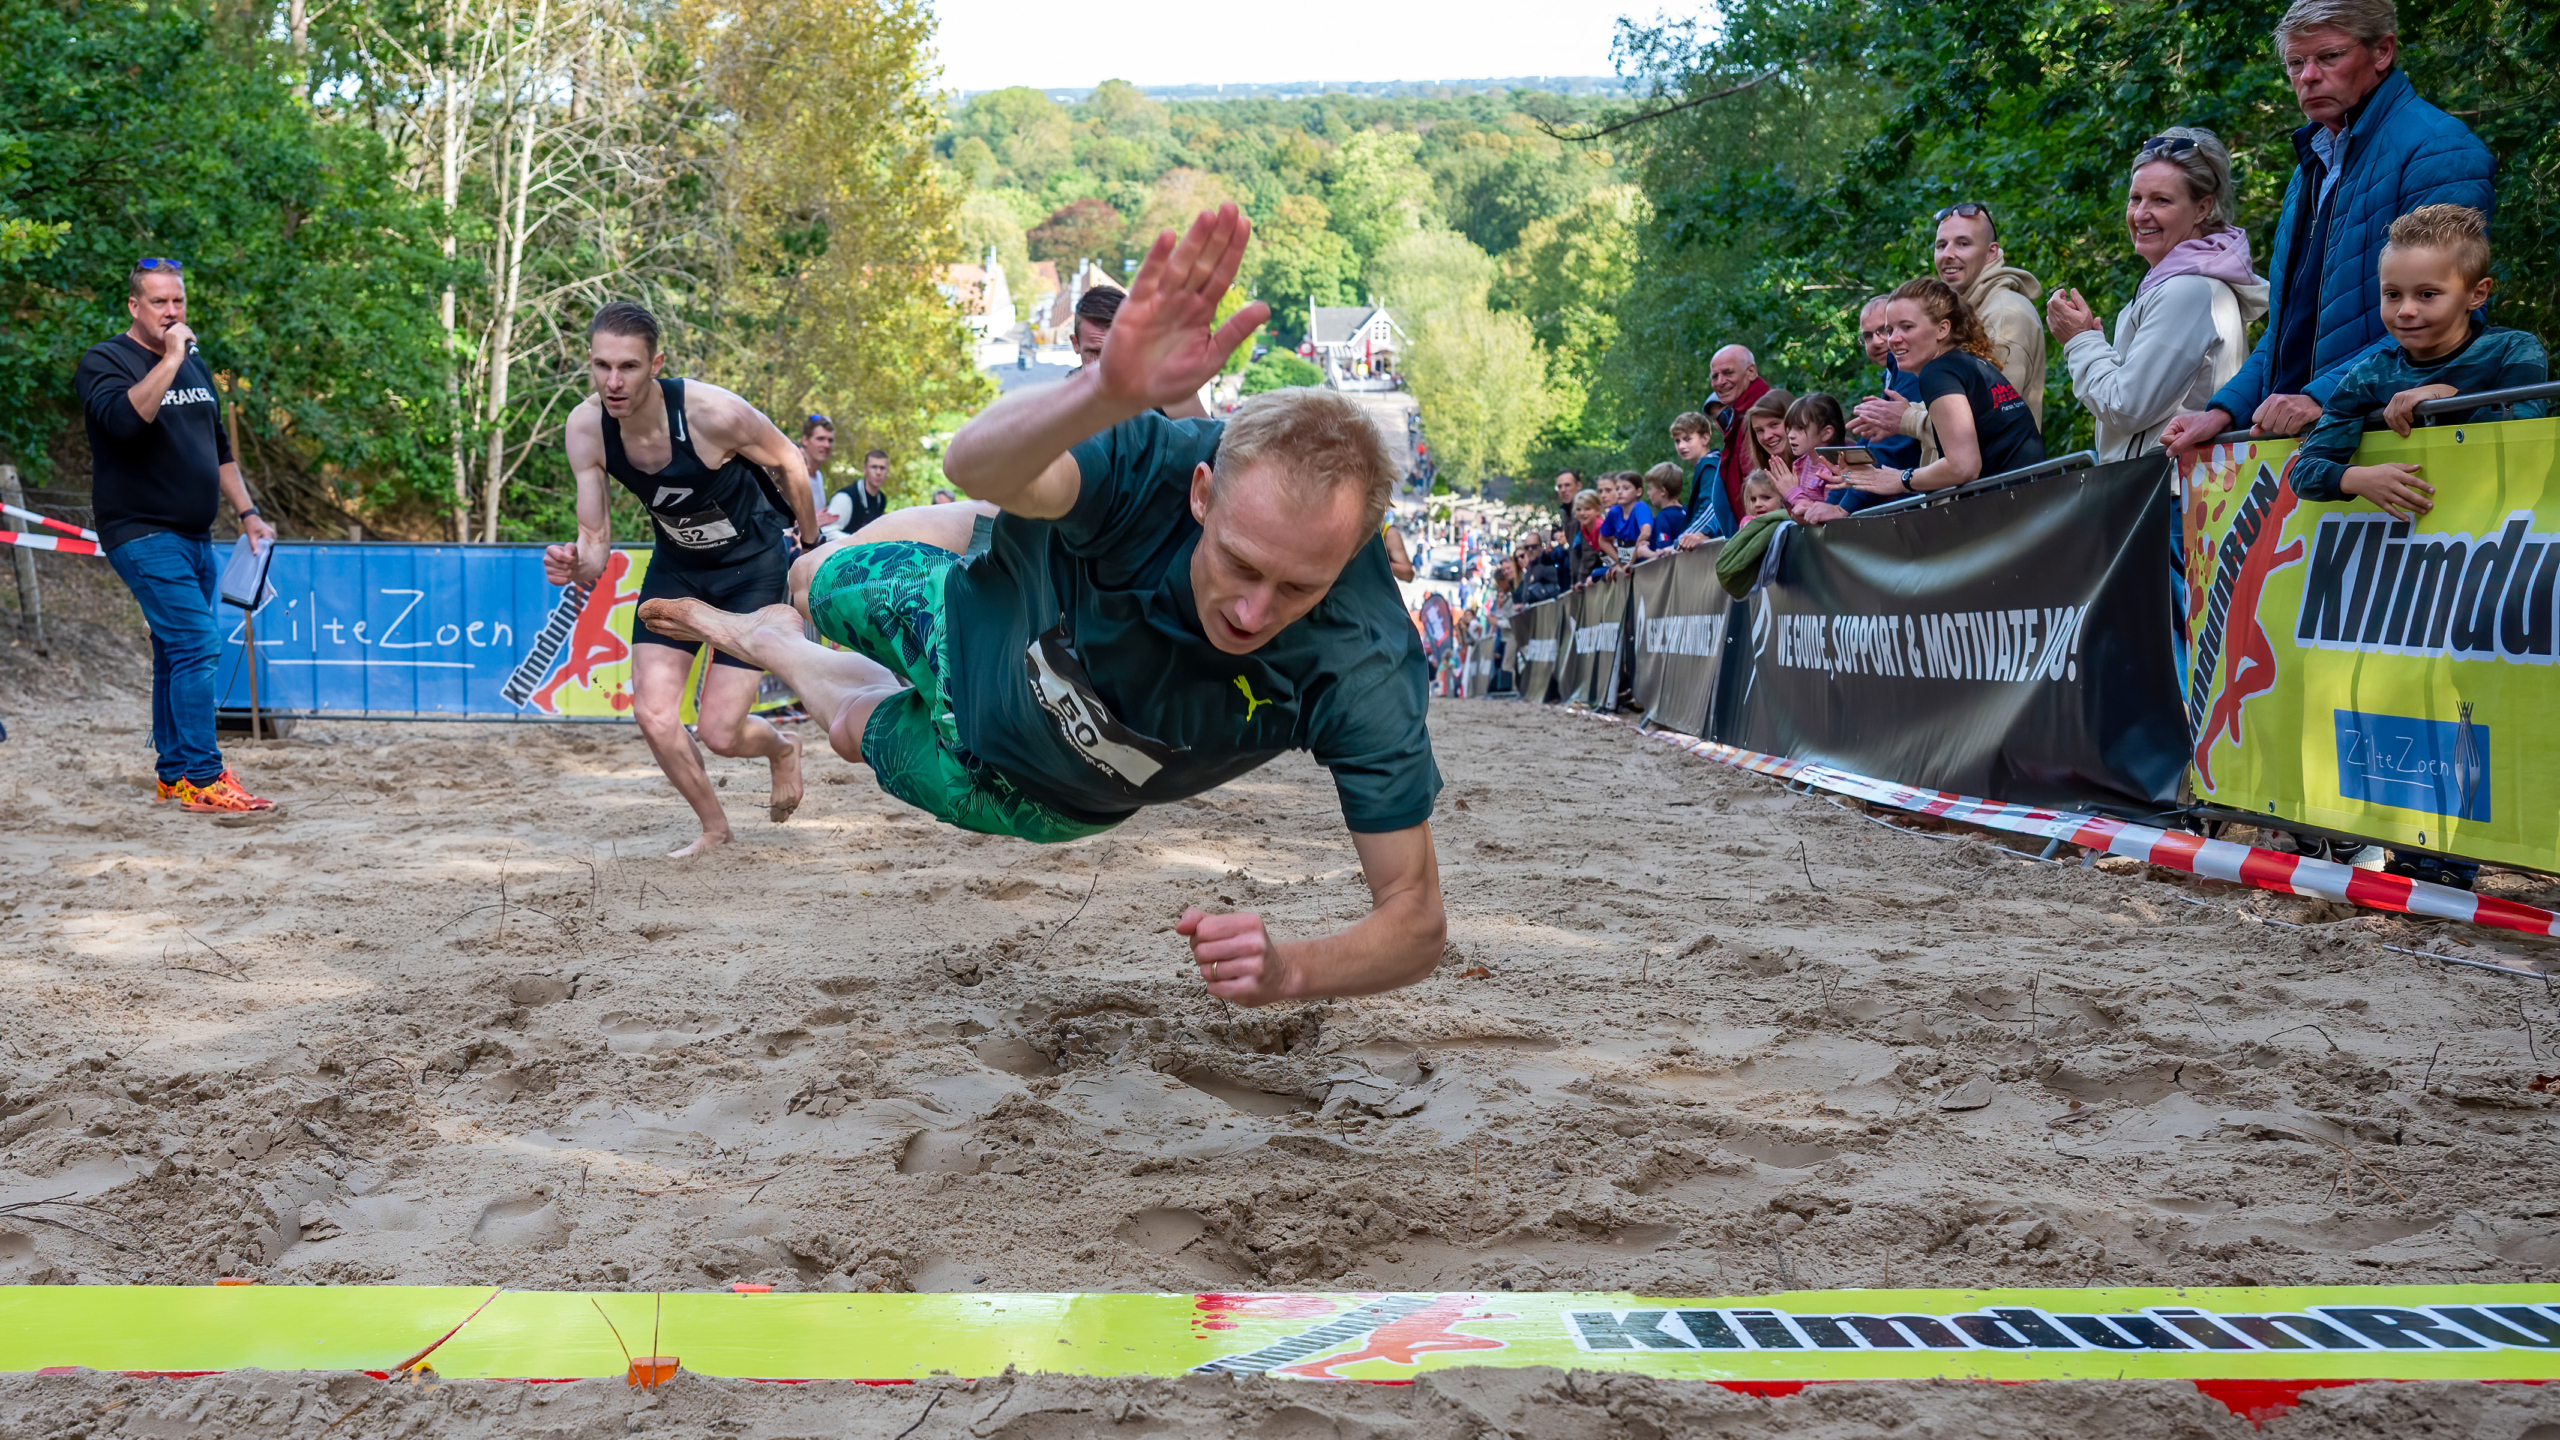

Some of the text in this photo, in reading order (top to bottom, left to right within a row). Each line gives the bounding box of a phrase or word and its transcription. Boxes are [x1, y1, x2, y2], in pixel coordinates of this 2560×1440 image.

[677, 529, 709, 543] 52
[2190, 462, 2279, 747] imduinRUN
[2298, 519, 2560, 656] Klimdu
[1777, 614, 1793, 666] WE
[1794, 614, 1834, 681] GUIDE,
[1832, 614, 1904, 677] SUPPORT
[1904, 613, 1925, 678] &
[1920, 608, 2039, 682] MOTIVATE
[1057, 691, 1099, 748] 50
[1571, 1306, 2560, 1349] KlimduinRU
